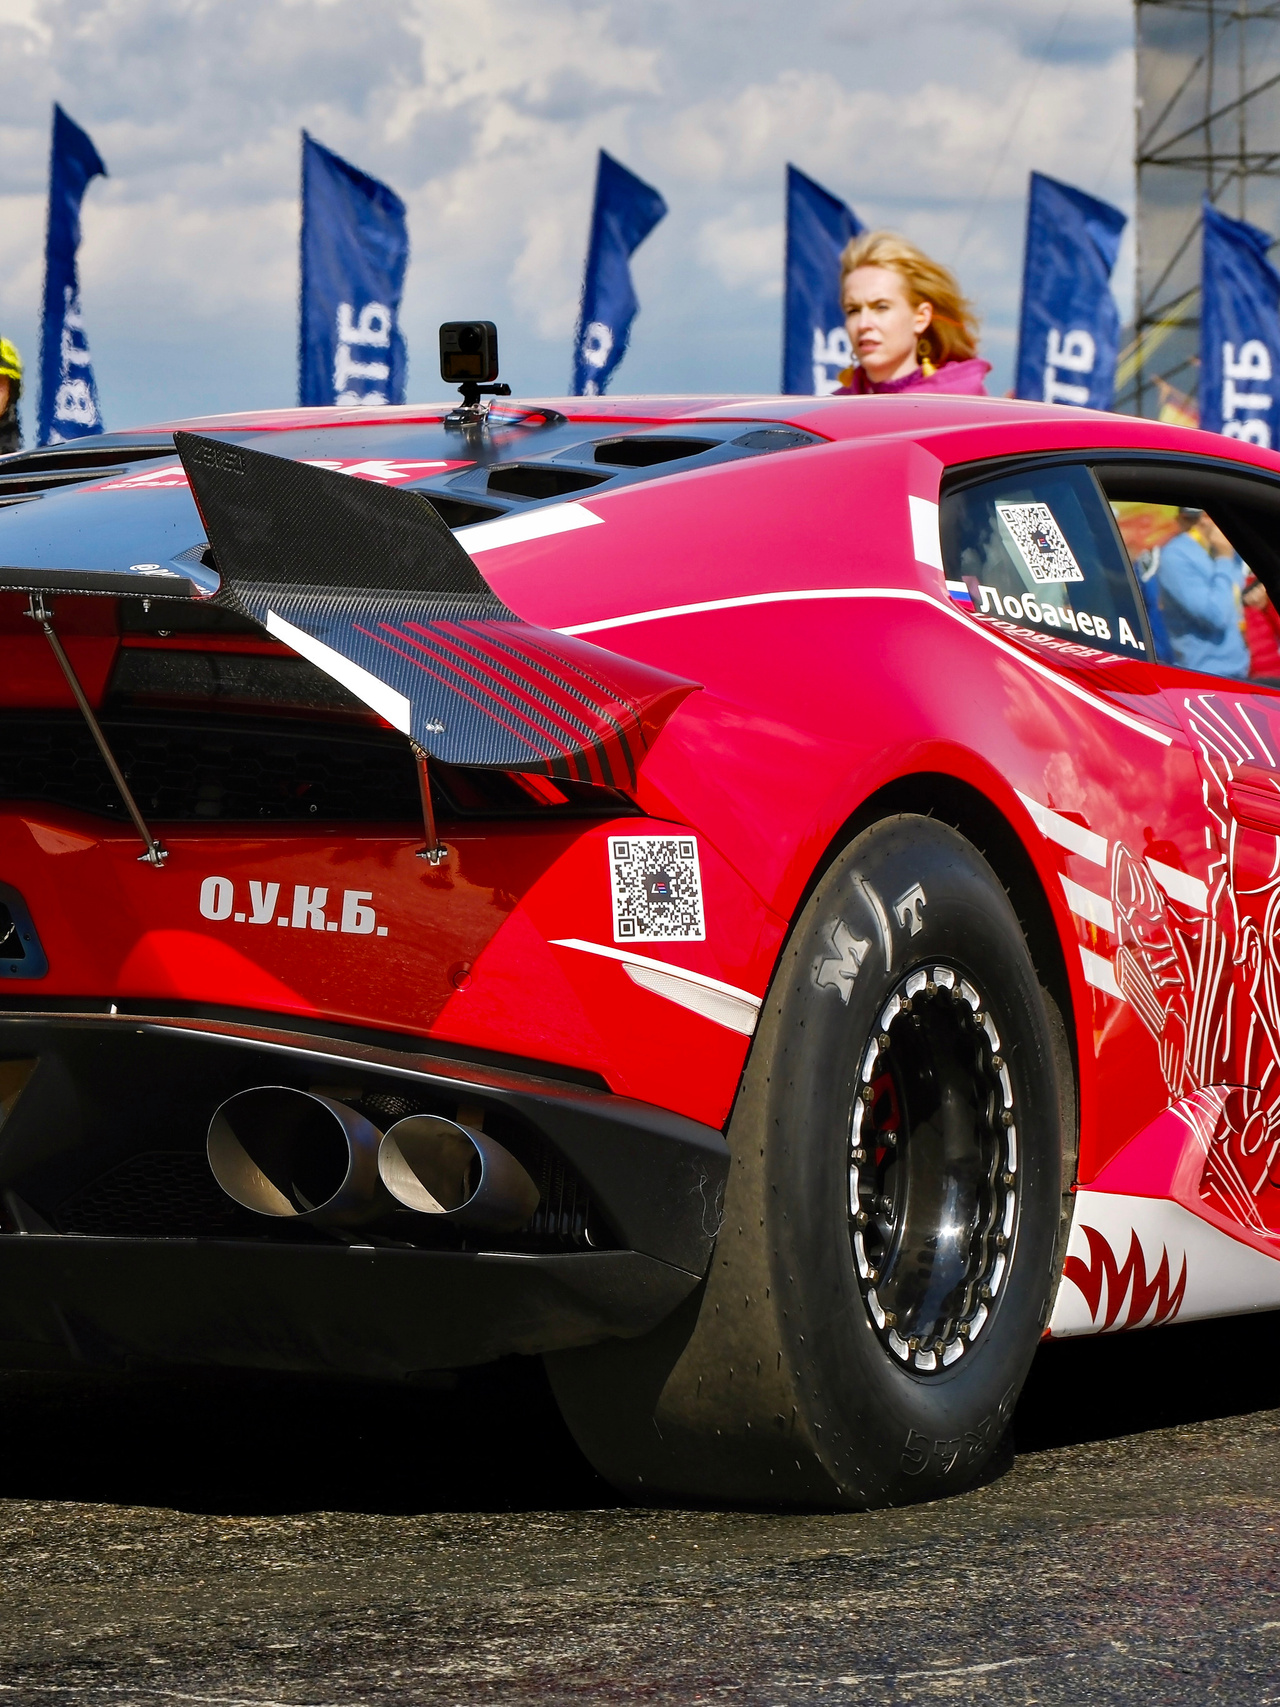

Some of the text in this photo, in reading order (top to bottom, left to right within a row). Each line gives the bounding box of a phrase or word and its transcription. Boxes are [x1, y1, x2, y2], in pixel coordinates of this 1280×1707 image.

[977, 584, 1146, 651] Лобачев А.
[199, 875, 389, 937] О.У.К.Б.
